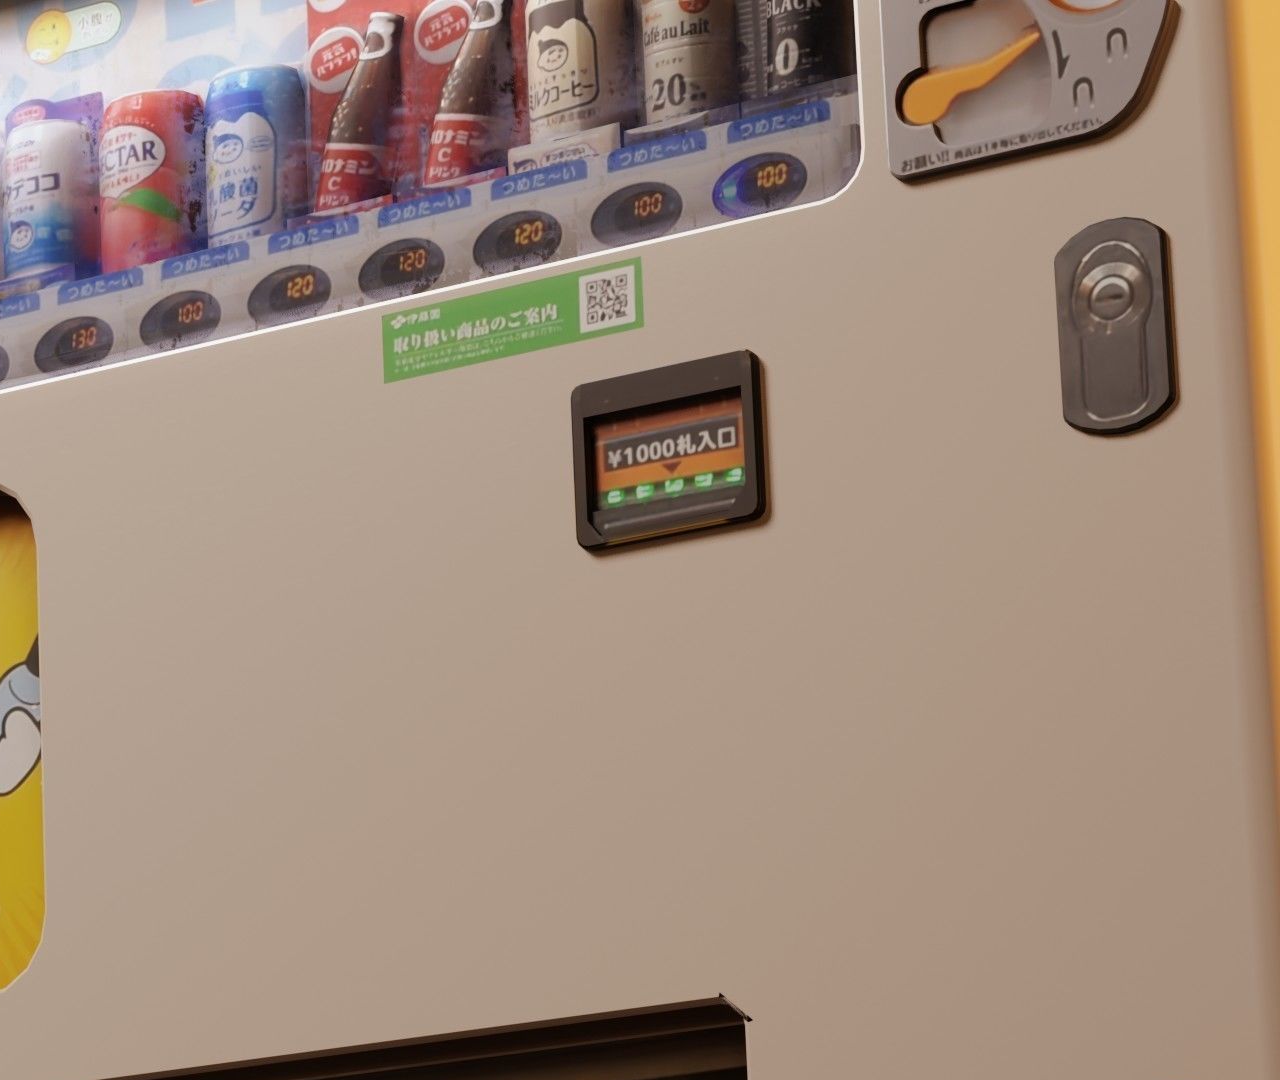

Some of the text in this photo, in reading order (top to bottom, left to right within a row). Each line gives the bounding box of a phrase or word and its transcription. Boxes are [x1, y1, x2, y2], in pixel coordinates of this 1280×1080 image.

[661, 26, 678, 40] au
[680, 17, 711, 37] Lait
[775, 38, 800, 77] 0
[651, 72, 687, 113] 20
[739, 108, 819, 139] つめた〜い
[430, 129, 485, 146] ロナミン
[101, 140, 161, 174] CTAR
[437, 146, 453, 163] C
[619, 136, 697, 168] つめた〜い
[322, 158, 377, 175] ロナミン
[756, 163, 788, 188] 100
[3, 172, 61, 201] タデココ
[327, 176, 342, 190] C
[502, 166, 577, 197] つめた〜い
[389, 193, 461, 221] つめた〜い
[633, 192, 663, 216] 100
[278, 220, 350, 247] つめた〜い
[514, 220, 544, 244] 120
[170, 247, 241, 275] つめた〜い
[399, 248, 426, 272] 120
[67, 268, 135, 300] つめた〜い
[286, 274, 314, 298] 120
[178, 301, 204, 324] 100
[71, 326, 97, 350] 130
[393, 303, 559, 354] 取り扱い商品のご案内
[607, 426, 736, 468] ¥1000札入口
